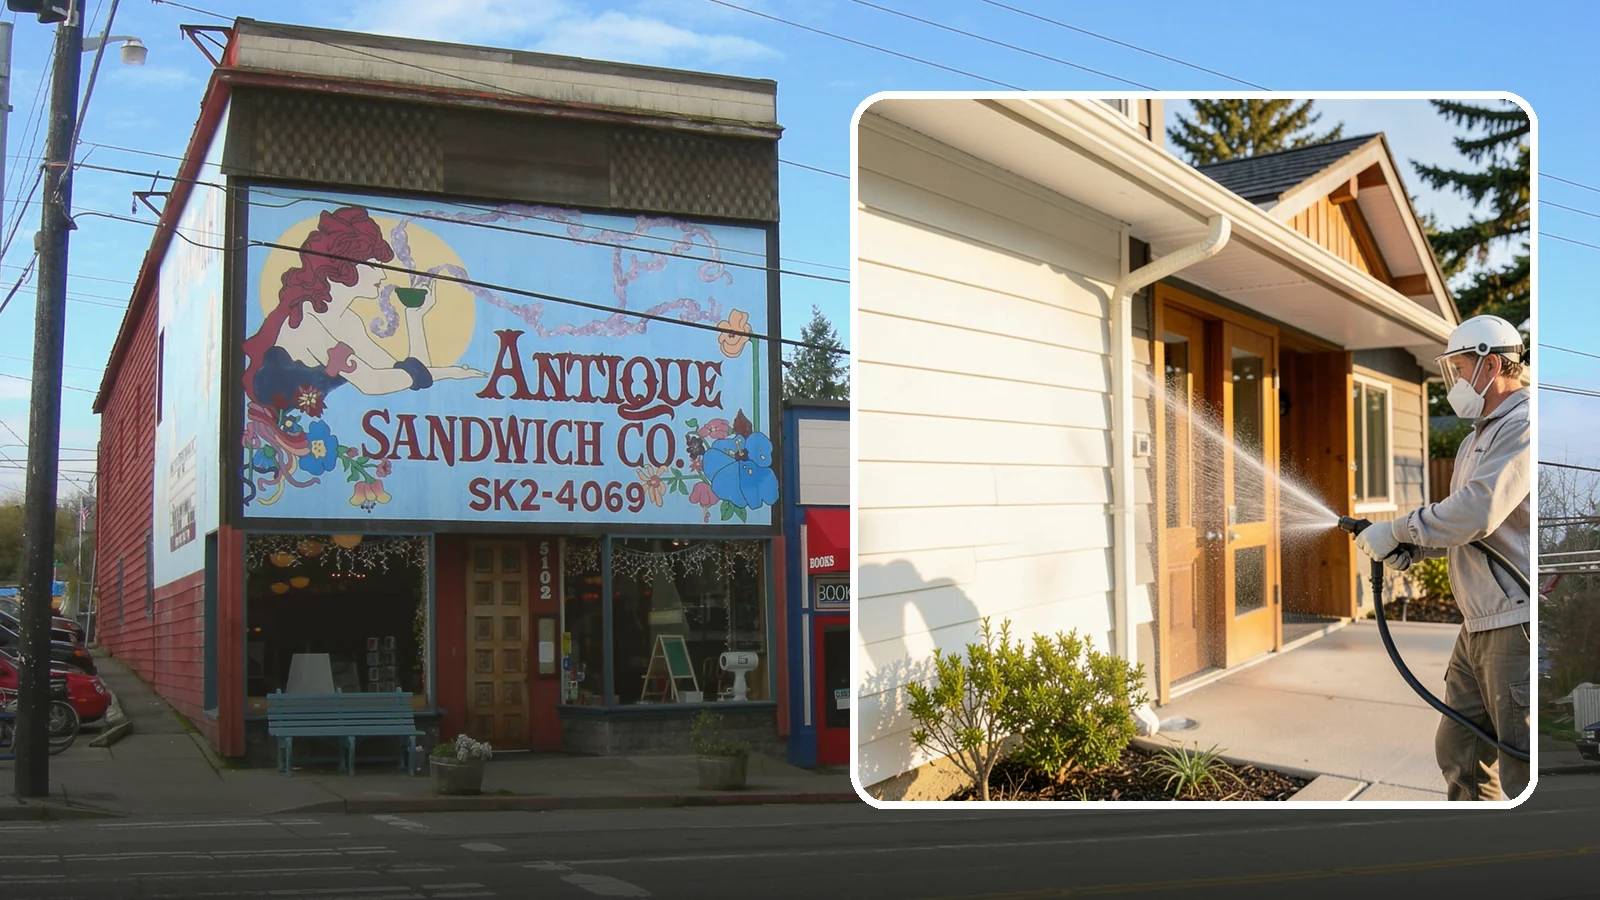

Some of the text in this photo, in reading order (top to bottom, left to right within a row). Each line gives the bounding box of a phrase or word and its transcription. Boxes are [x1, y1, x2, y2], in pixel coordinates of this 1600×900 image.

[476, 329, 723, 420] ANTIQUE
[361, 409, 684, 468] SANDWICH CO.
[468, 477, 645, 513] SK2-4069
[540, 542, 551, 599] 5102
[809, 555, 835, 569] BOOKS
